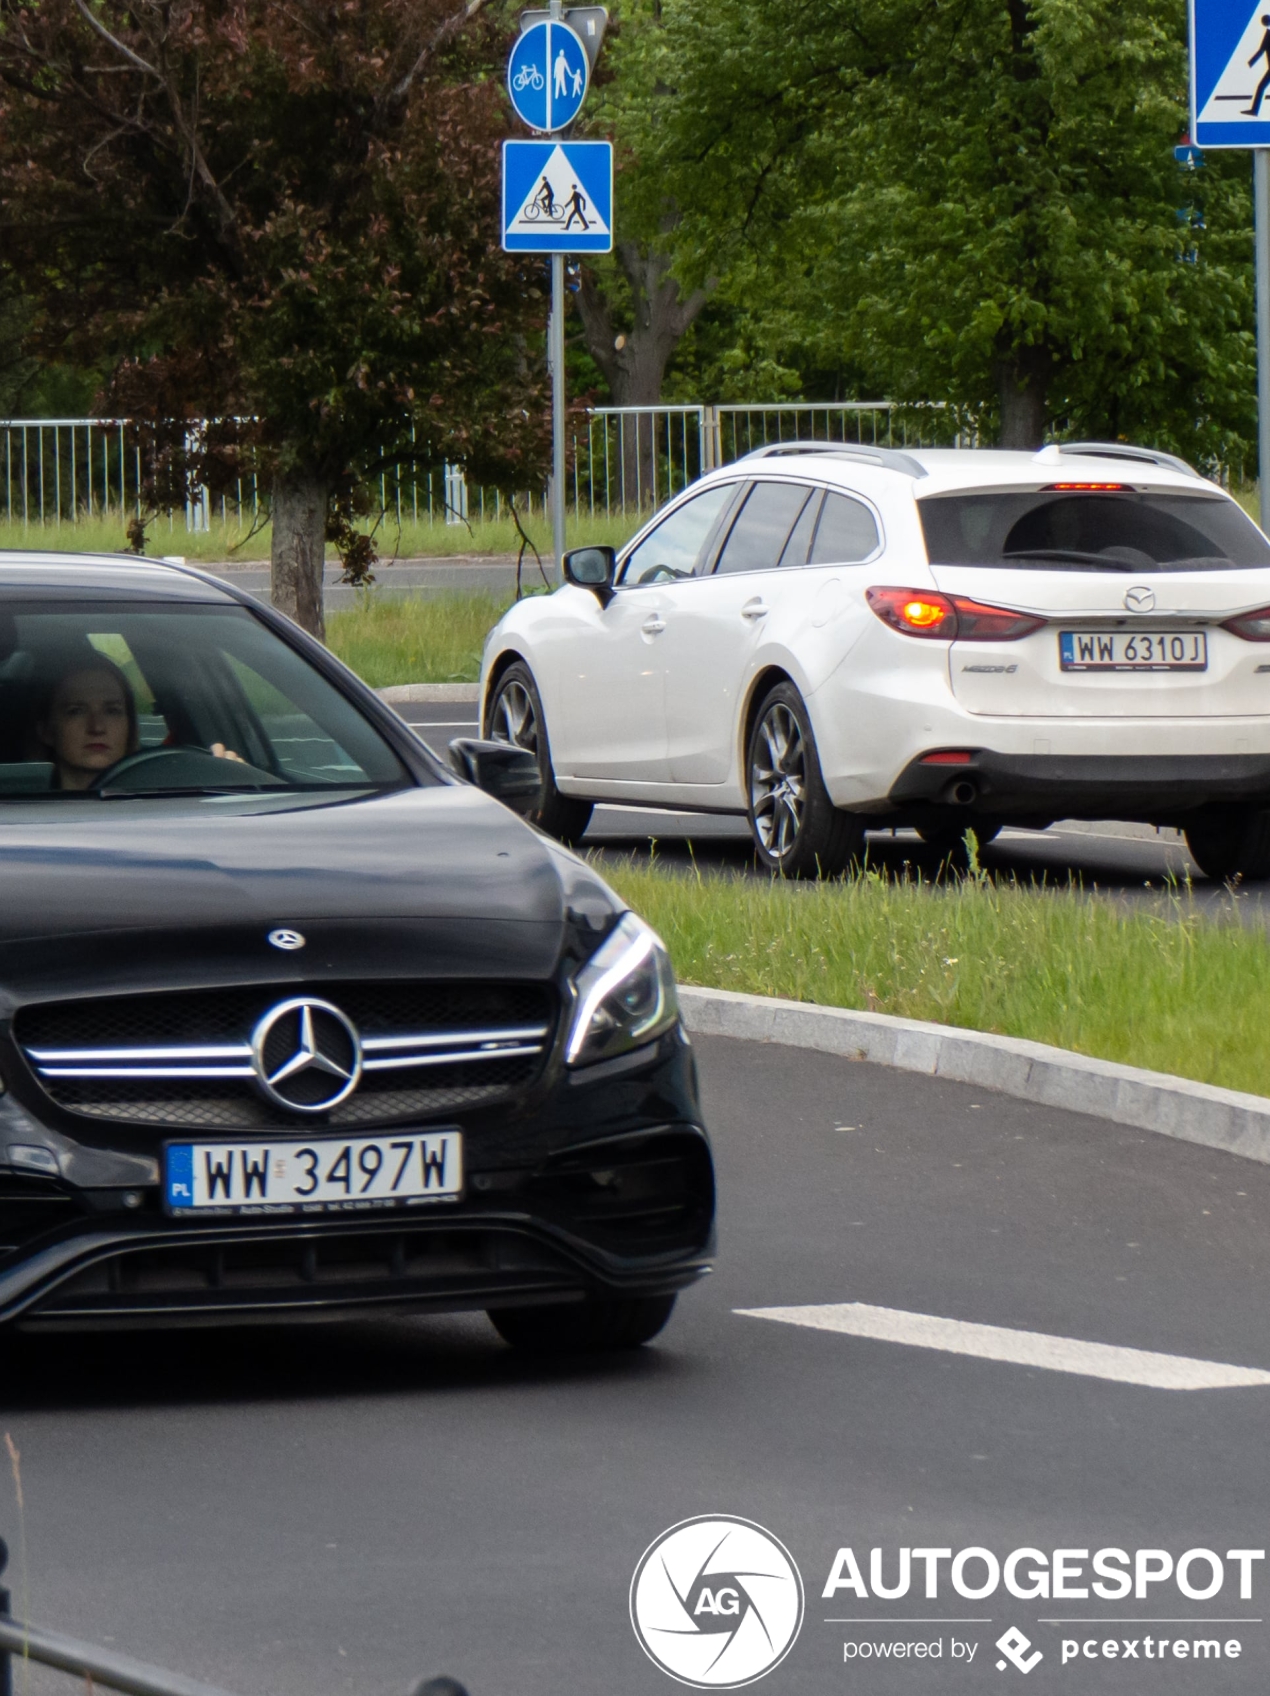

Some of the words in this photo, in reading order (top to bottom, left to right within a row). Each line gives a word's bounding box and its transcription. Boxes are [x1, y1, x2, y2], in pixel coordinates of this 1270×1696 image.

[1063, 652, 1073, 660] PL
[1078, 636, 1114, 661] WW
[1124, 636, 1199, 662] 6310J
[204, 1149, 270, 1199] WW
[293, 1138, 448, 1196] 3497W
[172, 1183, 191, 1197] PL
